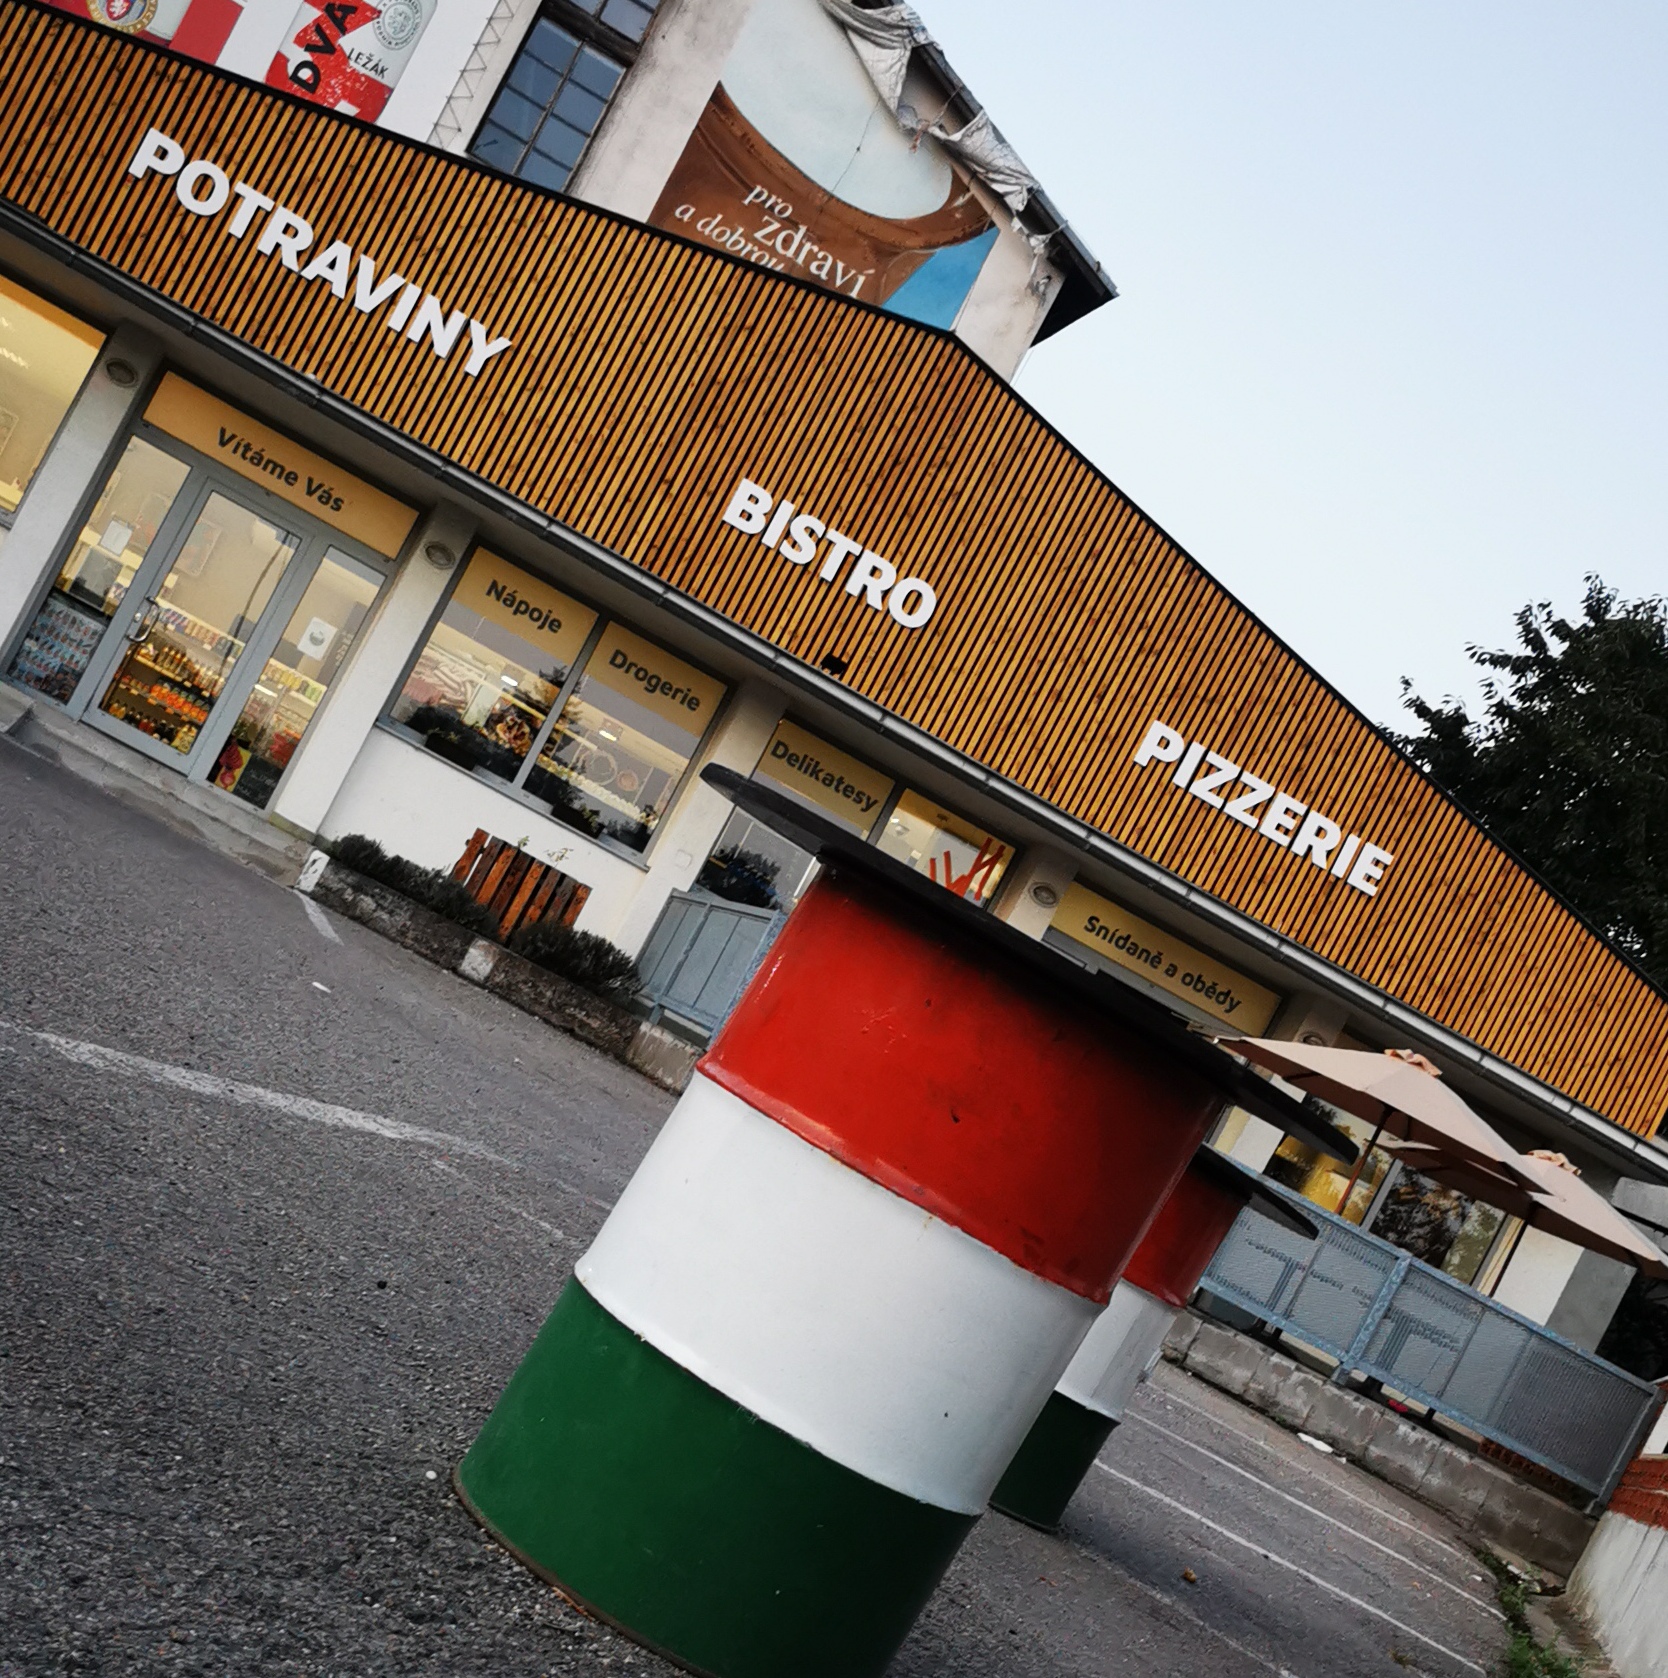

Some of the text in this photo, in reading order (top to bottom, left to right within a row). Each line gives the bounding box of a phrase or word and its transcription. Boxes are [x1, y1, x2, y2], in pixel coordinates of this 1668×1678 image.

[347, 48, 389, 79] LEŽÁK
[674, 204, 696, 222] a
[742, 185, 793, 218] pro
[128, 127, 511, 377] POTRAVINY
[754, 215, 876, 299] zdraví
[218, 427, 345, 512] Vítáme Vás
[722, 478, 937, 628] BISTRO
[486, 579, 562, 634] Nápoje
[609, 649, 701, 712] Drogerie
[770, 740, 880, 813] Delikatesy
[1134, 720, 1394, 897] PIZZERIE
[1084, 915, 1242, 1015] Snídaně a obědy
